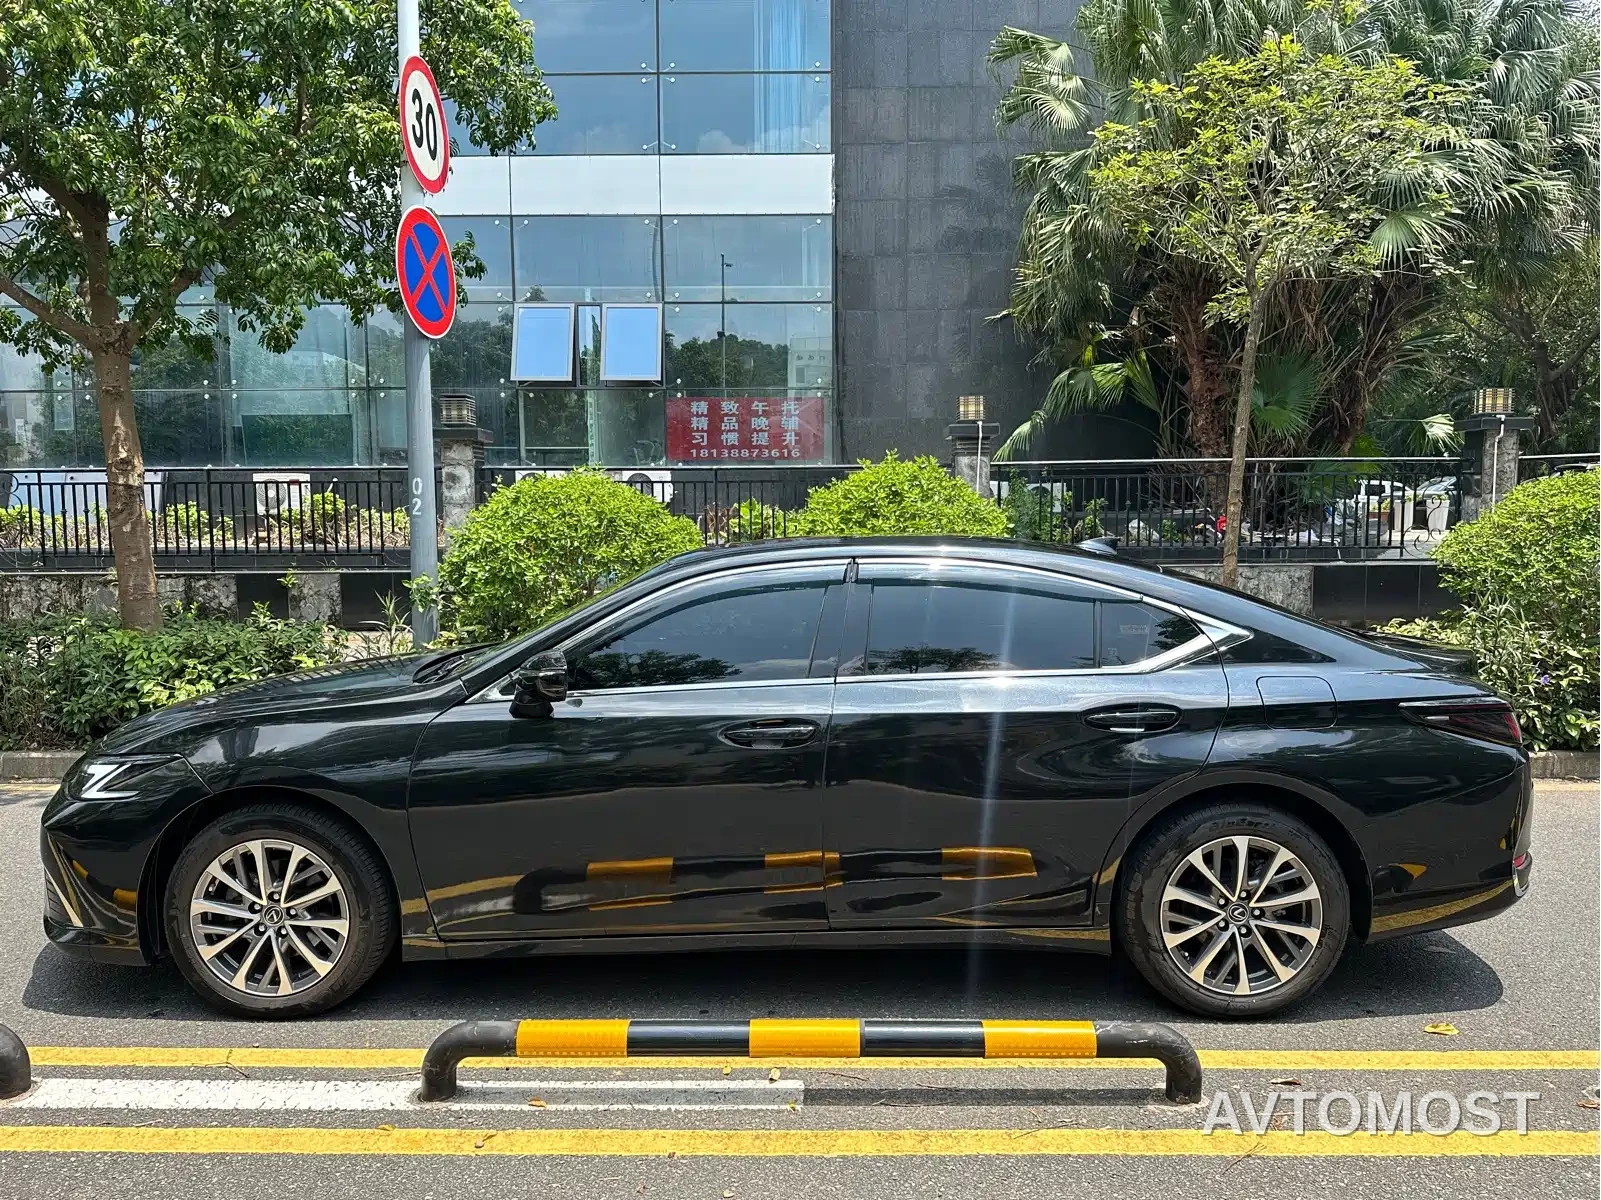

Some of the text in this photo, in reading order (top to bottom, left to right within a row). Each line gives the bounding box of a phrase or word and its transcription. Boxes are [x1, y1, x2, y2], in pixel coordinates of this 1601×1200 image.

[411, 88, 438, 161] 30
[690, 401, 800, 415] 精致午托
[690, 417, 800, 431] 精品晚辅
[691, 432, 800, 446] 习惯提升
[690, 448, 800, 458] 18138873616
[412, 477, 423, 516] 02
